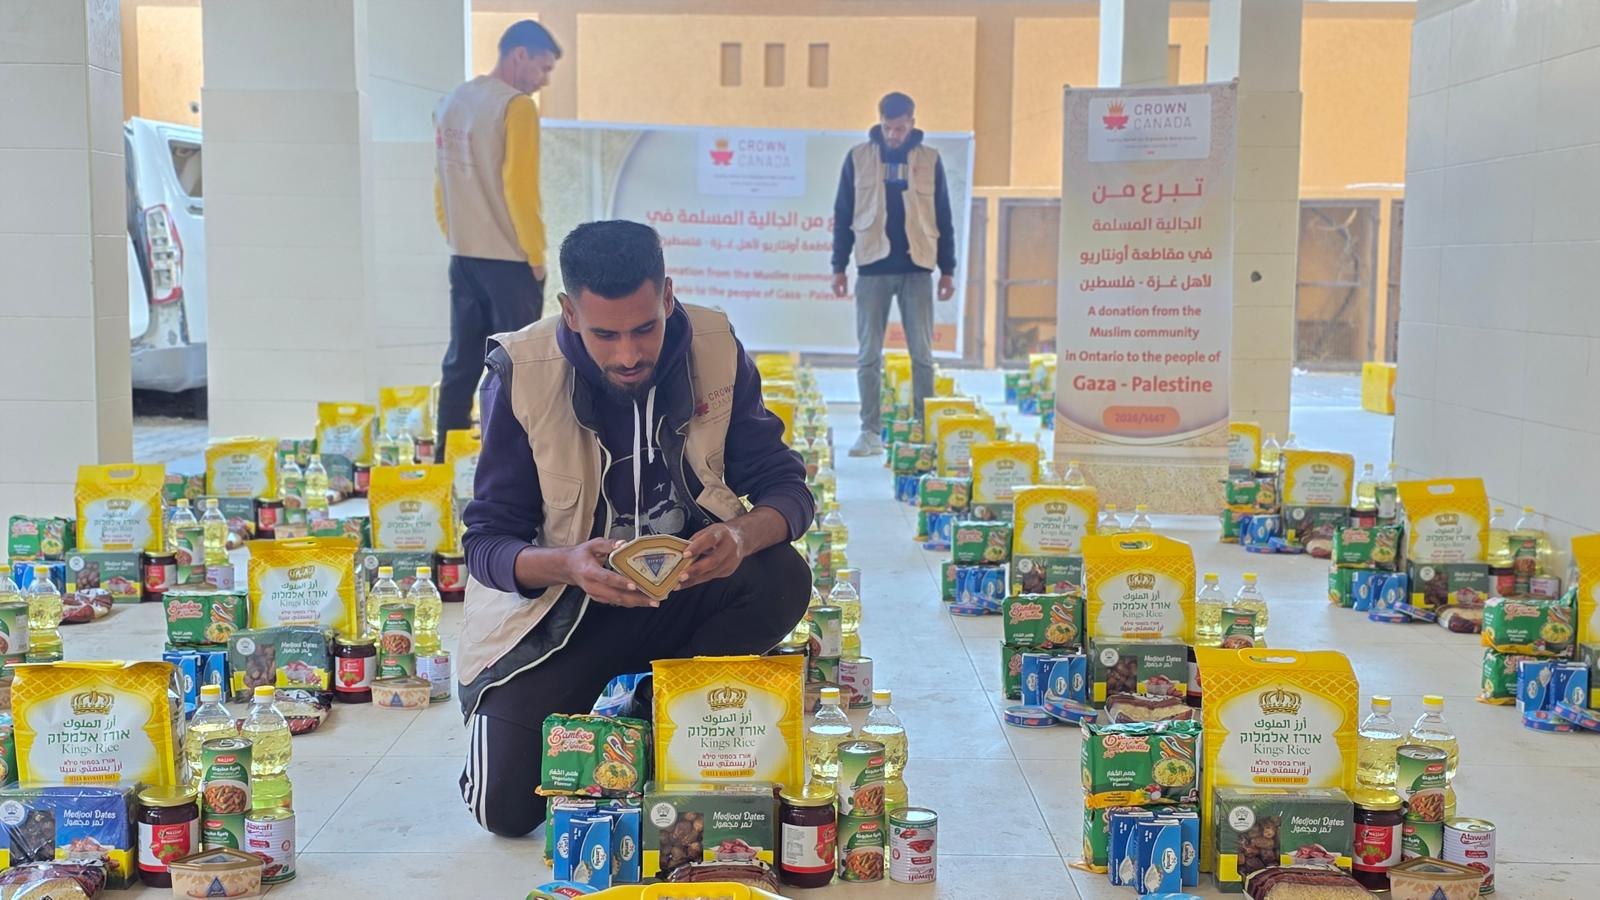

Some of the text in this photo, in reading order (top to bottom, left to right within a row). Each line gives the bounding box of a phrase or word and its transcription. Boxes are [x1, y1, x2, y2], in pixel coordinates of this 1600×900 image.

[1134, 102, 1187, 116] CROWN
[1134, 116, 1192, 129] CANADA
[738, 139, 786, 152] CROWN
[738, 154, 791, 168] CANADA
[646, 208, 674, 224] في
[678, 208, 744, 225] المسلمة
[748, 210, 798, 230] الجالية
[1092, 217, 1202, 234] الجالية المسلمة
[1080, 245, 1213, 265] في مقاطعة أونتاريو
[666, 266, 704, 277] onation
[1080, 275, 1136, 292] فلسطين
[1147, 275, 1178, 292] غزة
[1088, 306, 1202, 317] A donation from the
[1089, 327, 1200, 341] Muslim community
[1065, 351, 1222, 366] in Ontario to the people of
[1073, 375, 1117, 392] Gaza
[1132, 376, 1213, 393] Palestine
[1123, 592, 1149, 601] الملوك
[1113, 602, 1148, 611] אלמלוק
[1122, 610, 1164, 619] Kings Rice
[1166, 655, 1182, 663] Dates
[64, 715, 116, 731] أرز الملوك
[703, 710, 752, 726] أرز الملوك
[1255, 717, 1307, 732] أرز الملوك
[48, 729, 131, 745] אורז אלמלוק
[549, 727, 593, 745] Bamboo
[688, 725, 766, 739] אורז אלמלוק
[1240, 732, 1322, 745] אורז אלמלוק
[62, 744, 120, 757] Kings Rice
[701, 737, 756, 750] Kings Rice
[1254, 744, 1311, 758] Kings Rice
[63, 809, 117, 821] Medjool Dates
[713, 811, 766, 821] Medjool Dates
[1291, 816, 1345, 827] Medjool Dates
[63, 819, 104, 827] تمر مجهول
[713, 820, 753, 830] تمر مجهول
[1291, 826, 1332, 834] تمر مجهول
